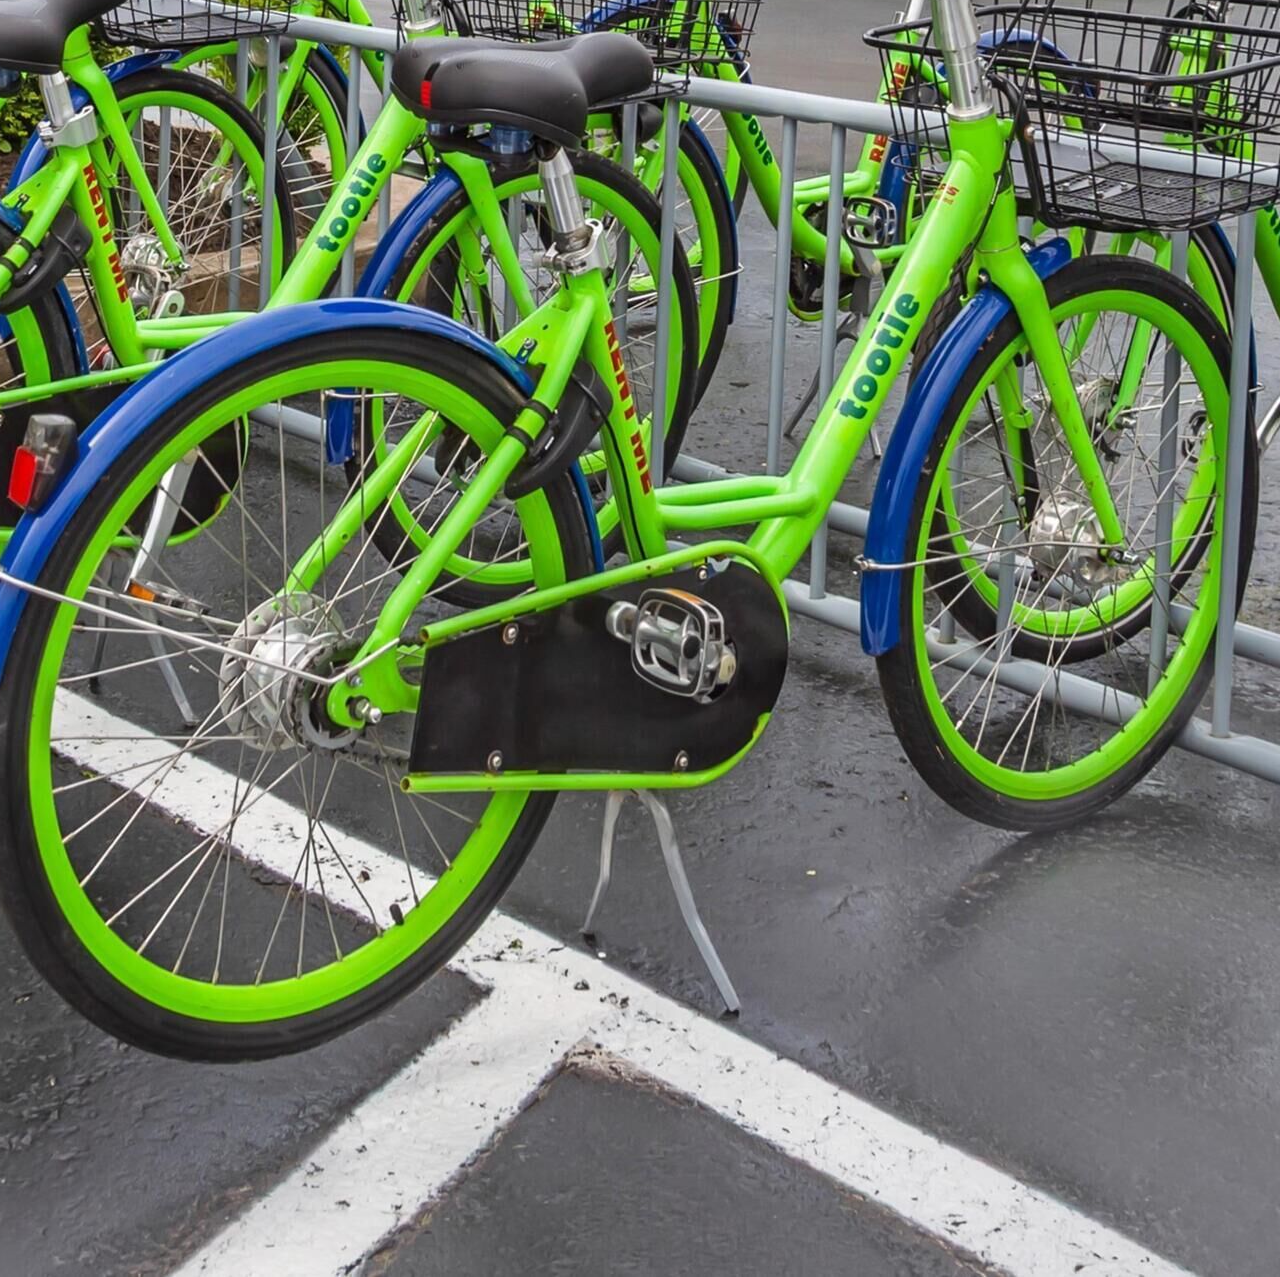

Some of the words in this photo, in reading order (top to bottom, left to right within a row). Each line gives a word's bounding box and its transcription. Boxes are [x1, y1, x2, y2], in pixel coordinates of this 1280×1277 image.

[316, 153, 387, 252] tootle
[742, 114, 774, 167] otle
[83, 163, 113, 244] RENT
[108, 252, 128, 303] ME
[604, 322, 635, 420] RENT
[630, 430, 652, 495] ME
[834, 293, 920, 419] tootle
